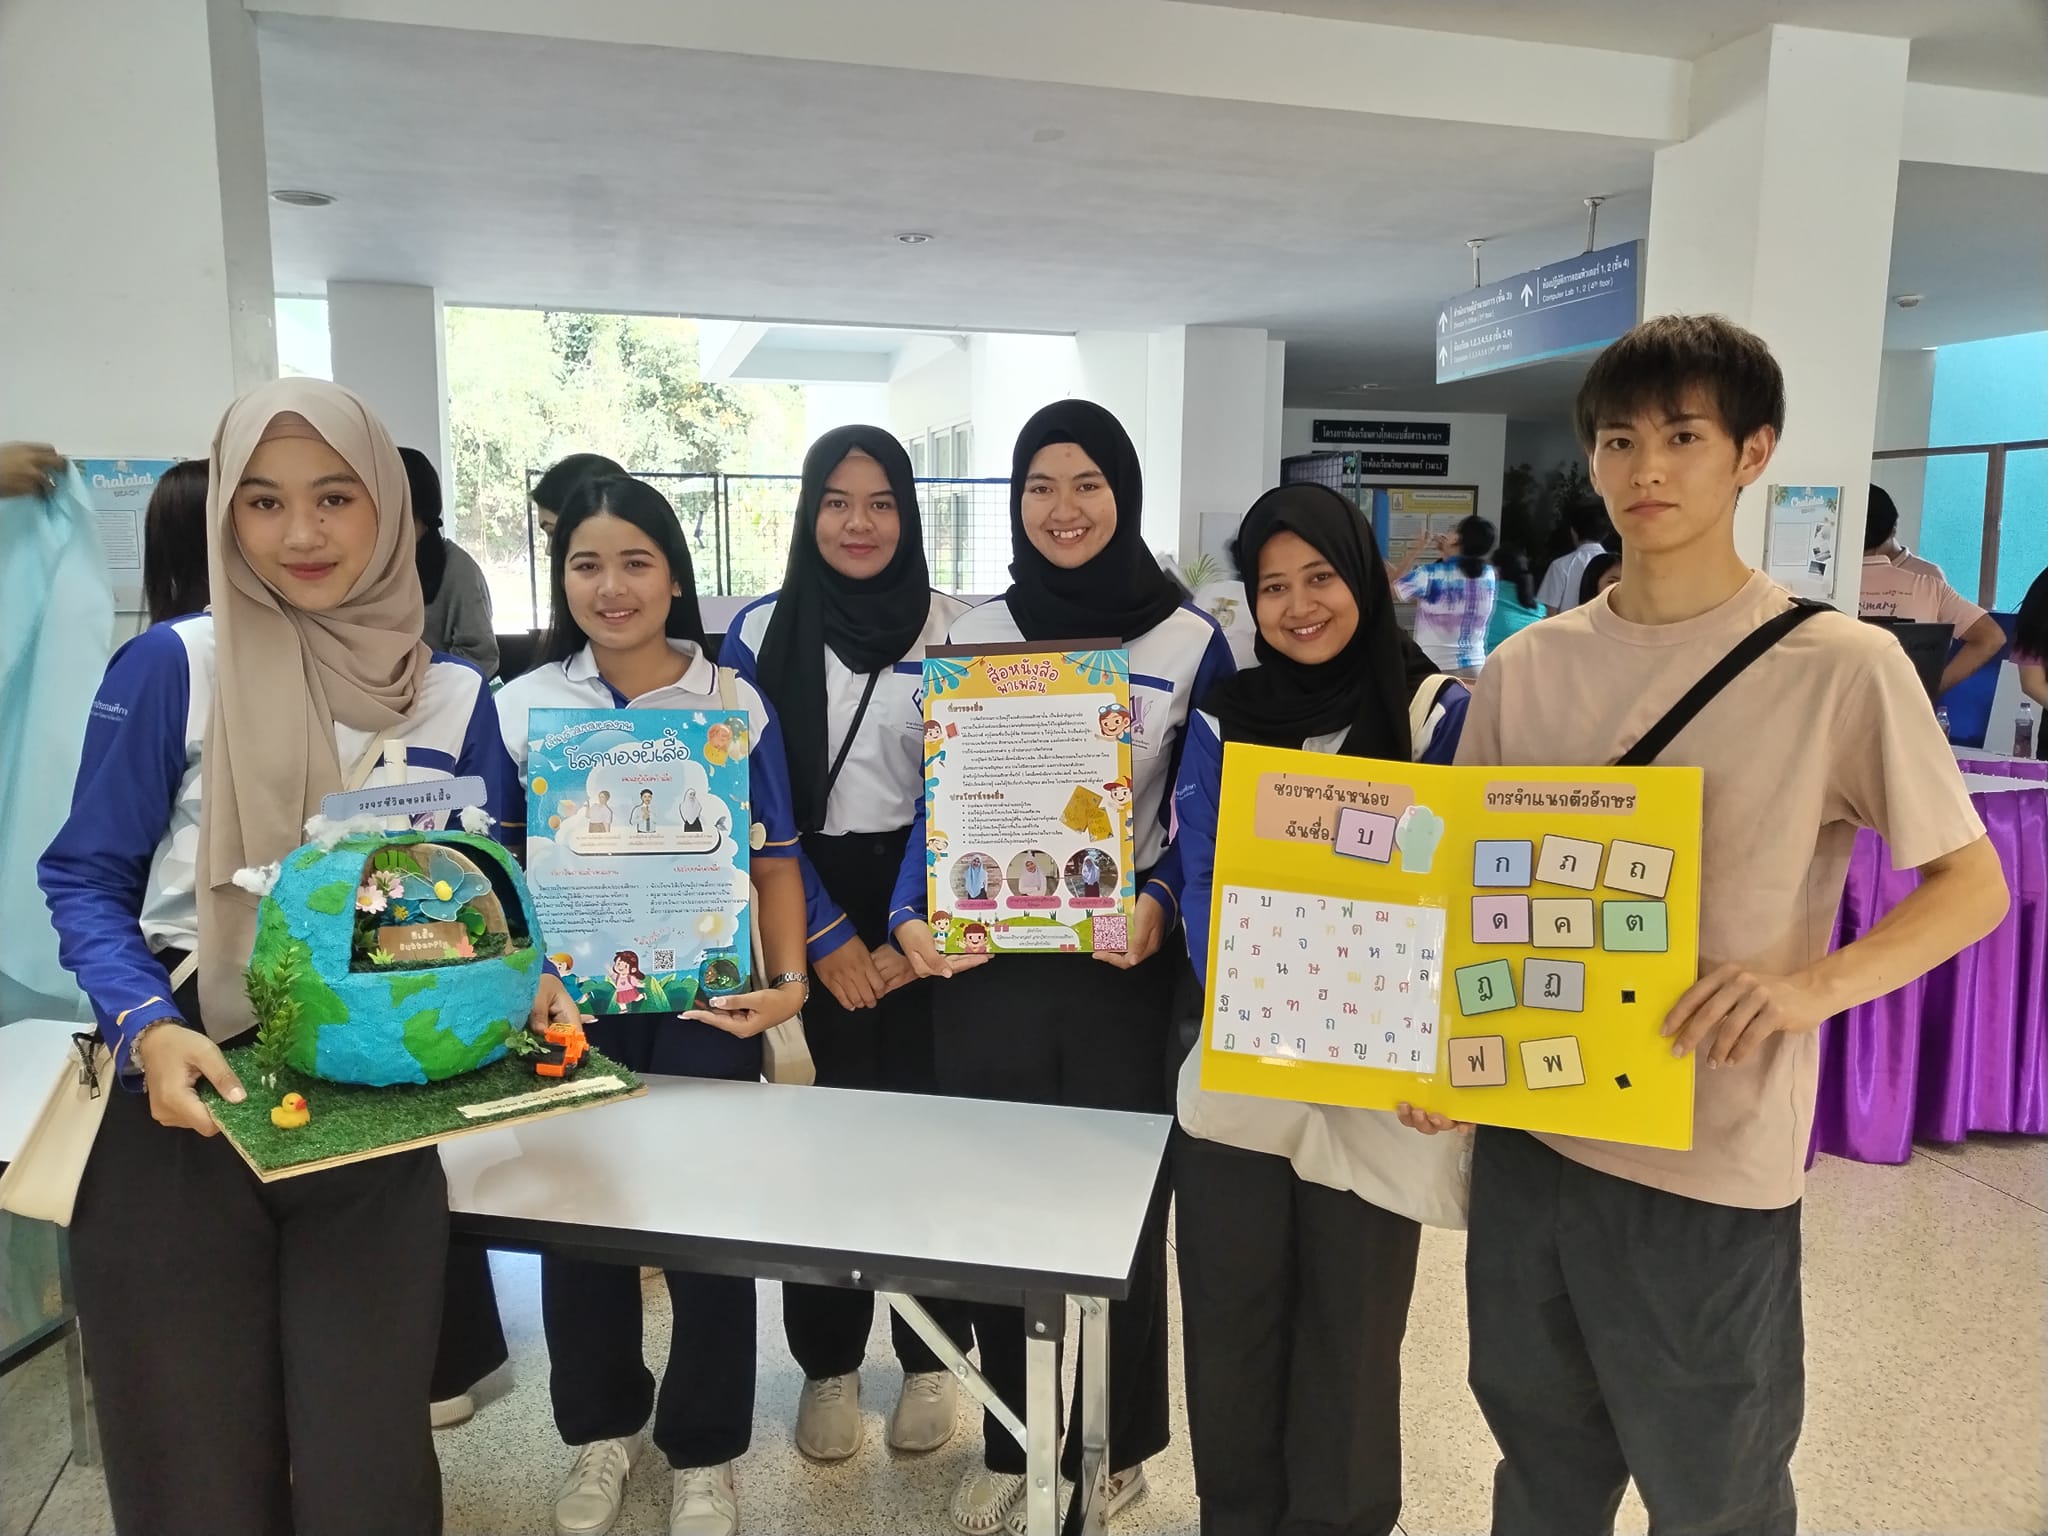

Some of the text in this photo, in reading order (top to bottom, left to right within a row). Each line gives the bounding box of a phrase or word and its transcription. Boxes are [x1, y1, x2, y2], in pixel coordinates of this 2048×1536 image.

[1543, 291, 1564, 302] Computer
[1565, 288, 1574, 297] Lab
[987, 658, 1059, 684] สื่อหนังสือ
[997, 675, 1046, 694] พาเพลิน
[564, 728, 690, 769] โลกของผีเสื้อ
[1274, 773, 1389, 806] ช่วยหาฉันหน่อย
[1487, 788, 1636, 809] การจำแนกตัวอักษร
[1357, 827, 1374, 845] บ
[1495, 856, 1510, 873] ก
[1559, 855, 1577, 872] ภ
[1630, 861, 1646, 879] ถ
[1228, 893, 1239, 904] ก
[1260, 895, 1272, 907] บ
[1295, 906, 1306, 918] ก
[1342, 901, 1354, 918] ฟ
[1239, 917, 1250, 929] ส
[1492, 913, 1508, 929] ด
[1554, 916, 1571, 933] ค
[1626, 914, 1643, 931] ต
[1224, 935, 1235, 951] ฝ
[1298, 938, 1308, 950] จ
[1251, 944, 1261, 956] ธ
[1337, 945, 1349, 958] พ
[1369, 946, 1380, 959] ห
[1228, 967, 1238, 979] ค
[1276, 962, 1288, 975] น
[1308, 963, 1320, 975] ษ
[1420, 969, 1429, 981] ล
[1477, 976, 1493, 1001] ฎ
[1544, 973, 1561, 998] ฏ
[1238, 1009, 1250, 1021] ฆ
[1342, 1002, 1358, 1015] ณ
[1326, 1018, 1335, 1030] ถ
[1403, 1016, 1412, 1028] ร
[1420, 1022, 1432, 1034] ม
[1253, 1037, 1260, 1048] ง
[1271, 1032, 1280, 1045] อ
[1354, 1042, 1367, 1060] ญ
[1387, 1051, 1398, 1064] ภ
[1411, 1050, 1420, 1062] ย
[1468, 1046, 1485, 1072] ฟ
[1543, 1054, 1563, 1072] พ
